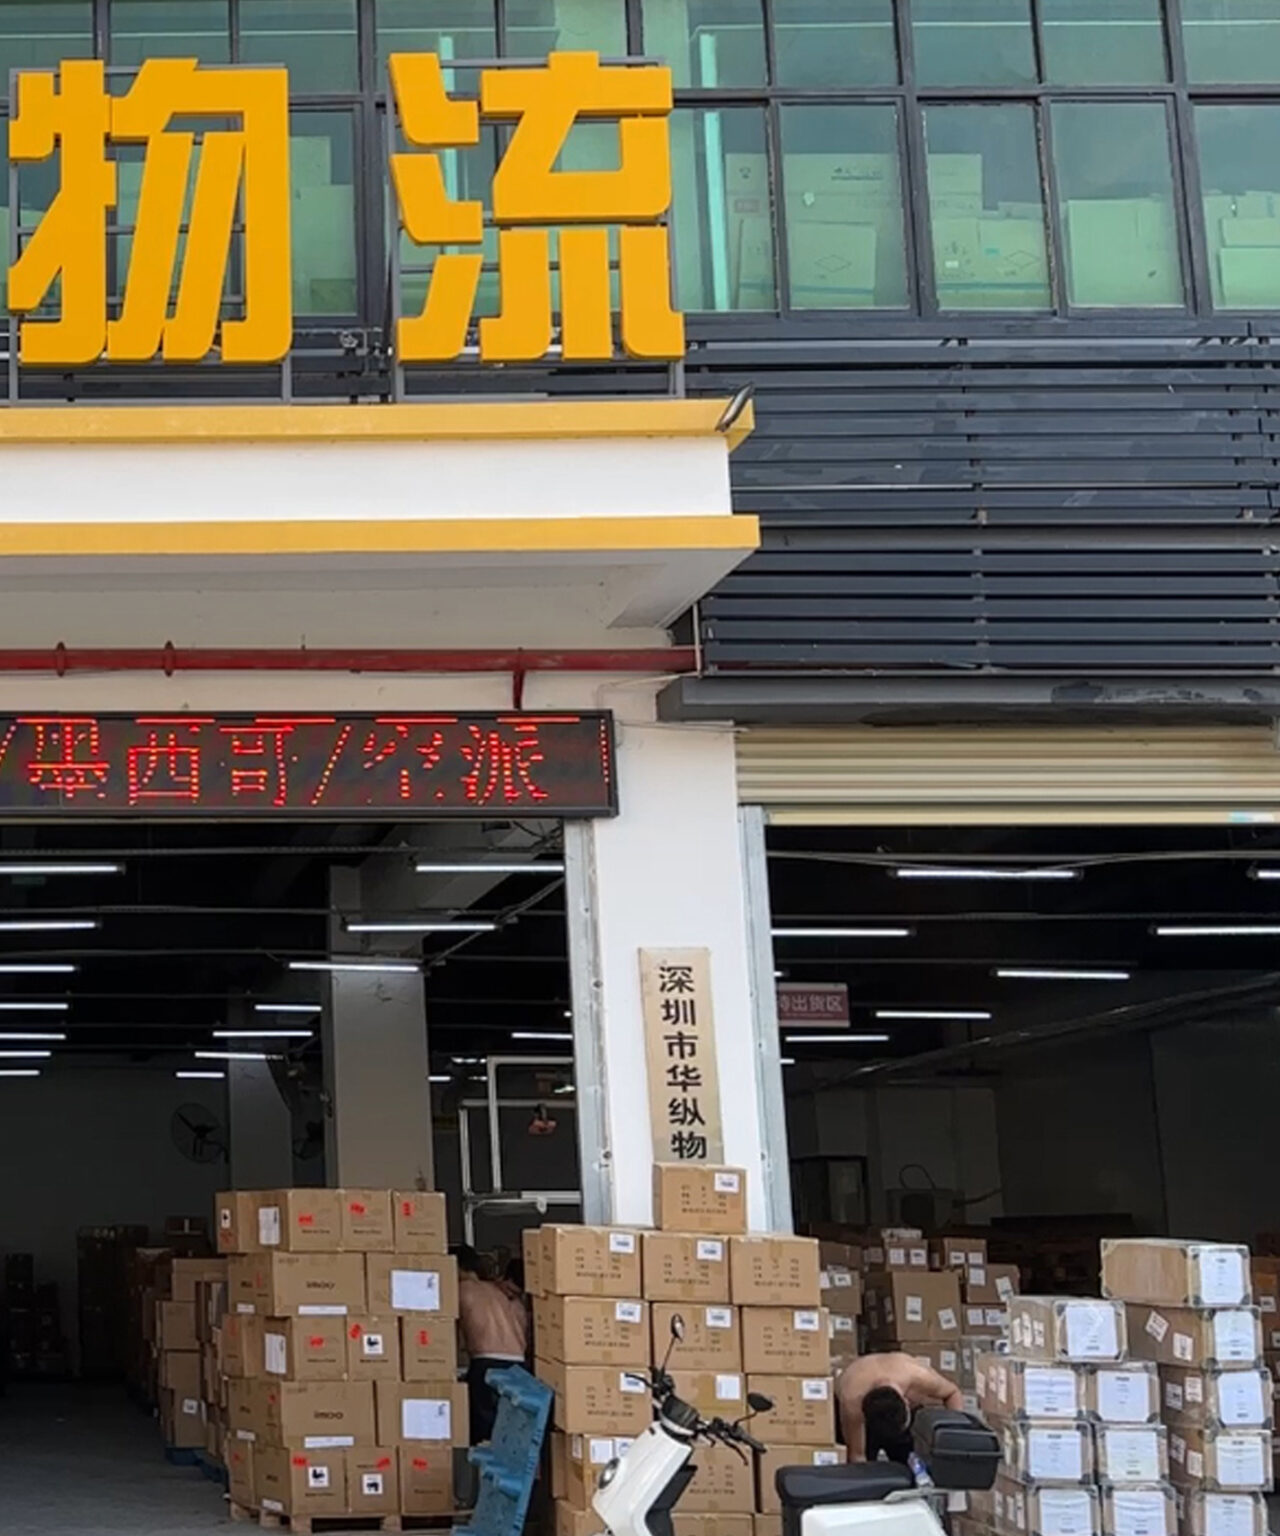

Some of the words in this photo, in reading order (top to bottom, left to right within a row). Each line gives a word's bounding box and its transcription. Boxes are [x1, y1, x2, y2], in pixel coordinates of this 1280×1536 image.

[658, 965, 708, 1160] 深圳市华纵物
